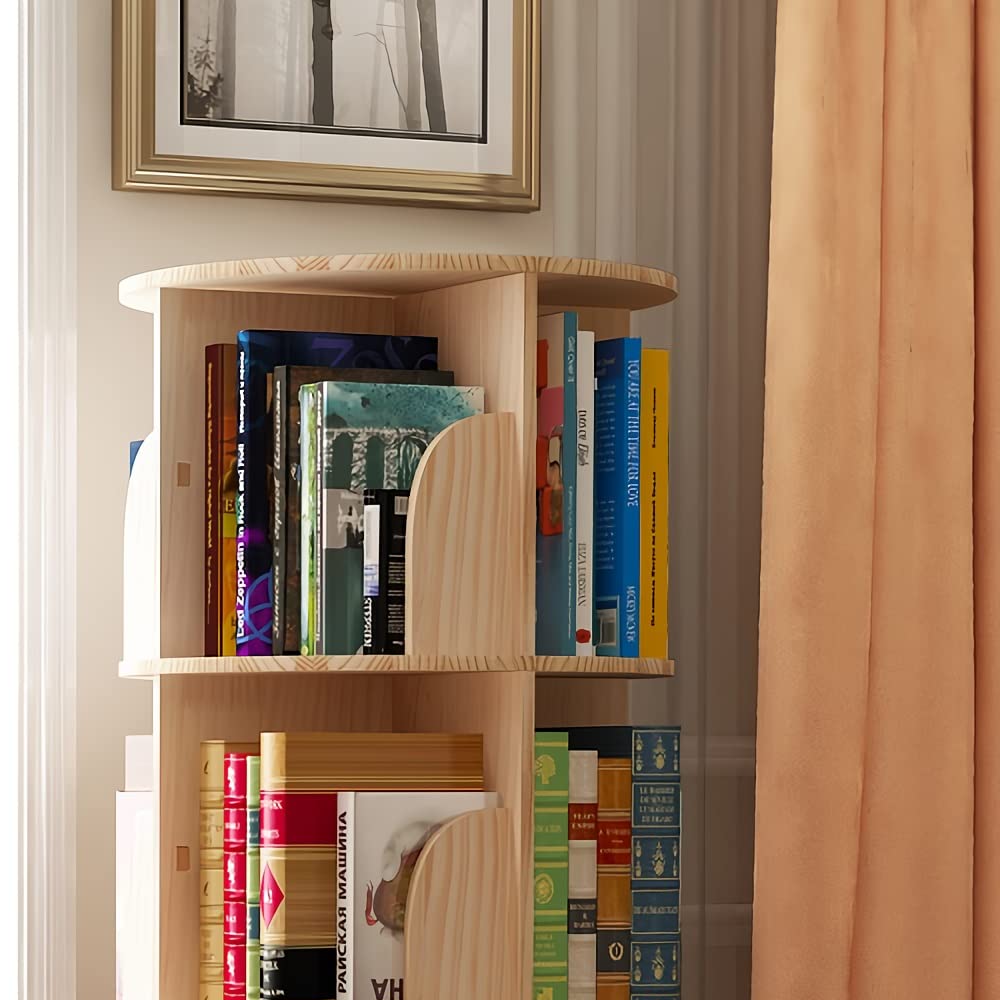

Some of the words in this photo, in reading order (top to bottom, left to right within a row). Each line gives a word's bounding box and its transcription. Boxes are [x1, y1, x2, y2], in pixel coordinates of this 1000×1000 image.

[627, 483, 639, 507] LOVE
[237, 526, 244, 539] in
[236, 542, 246, 607] Zeppelin
[236, 609, 244, 638] Led
[338, 811, 347, 900] МАШИНА
